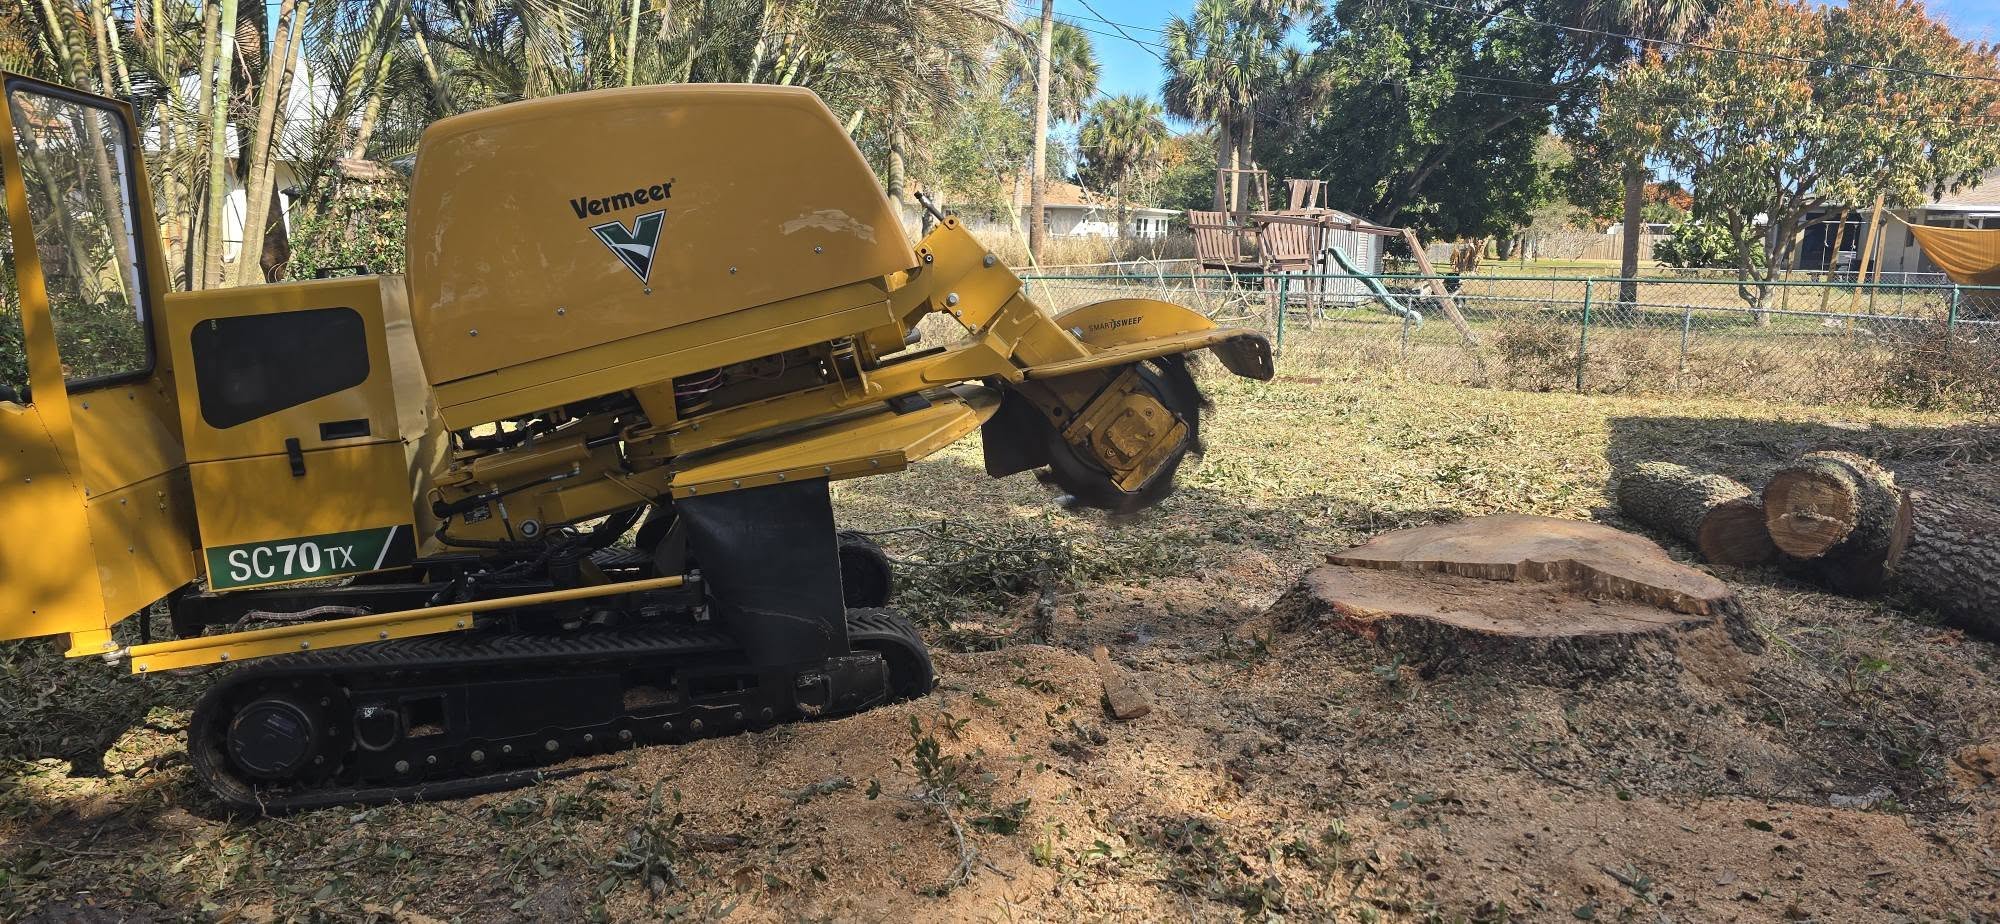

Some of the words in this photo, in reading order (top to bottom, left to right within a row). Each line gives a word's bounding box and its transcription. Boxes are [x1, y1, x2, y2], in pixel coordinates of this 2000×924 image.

[570, 182, 672, 220] Vermeer
[228, 542, 321, 582] SC70
[324, 546, 357, 570] TX
